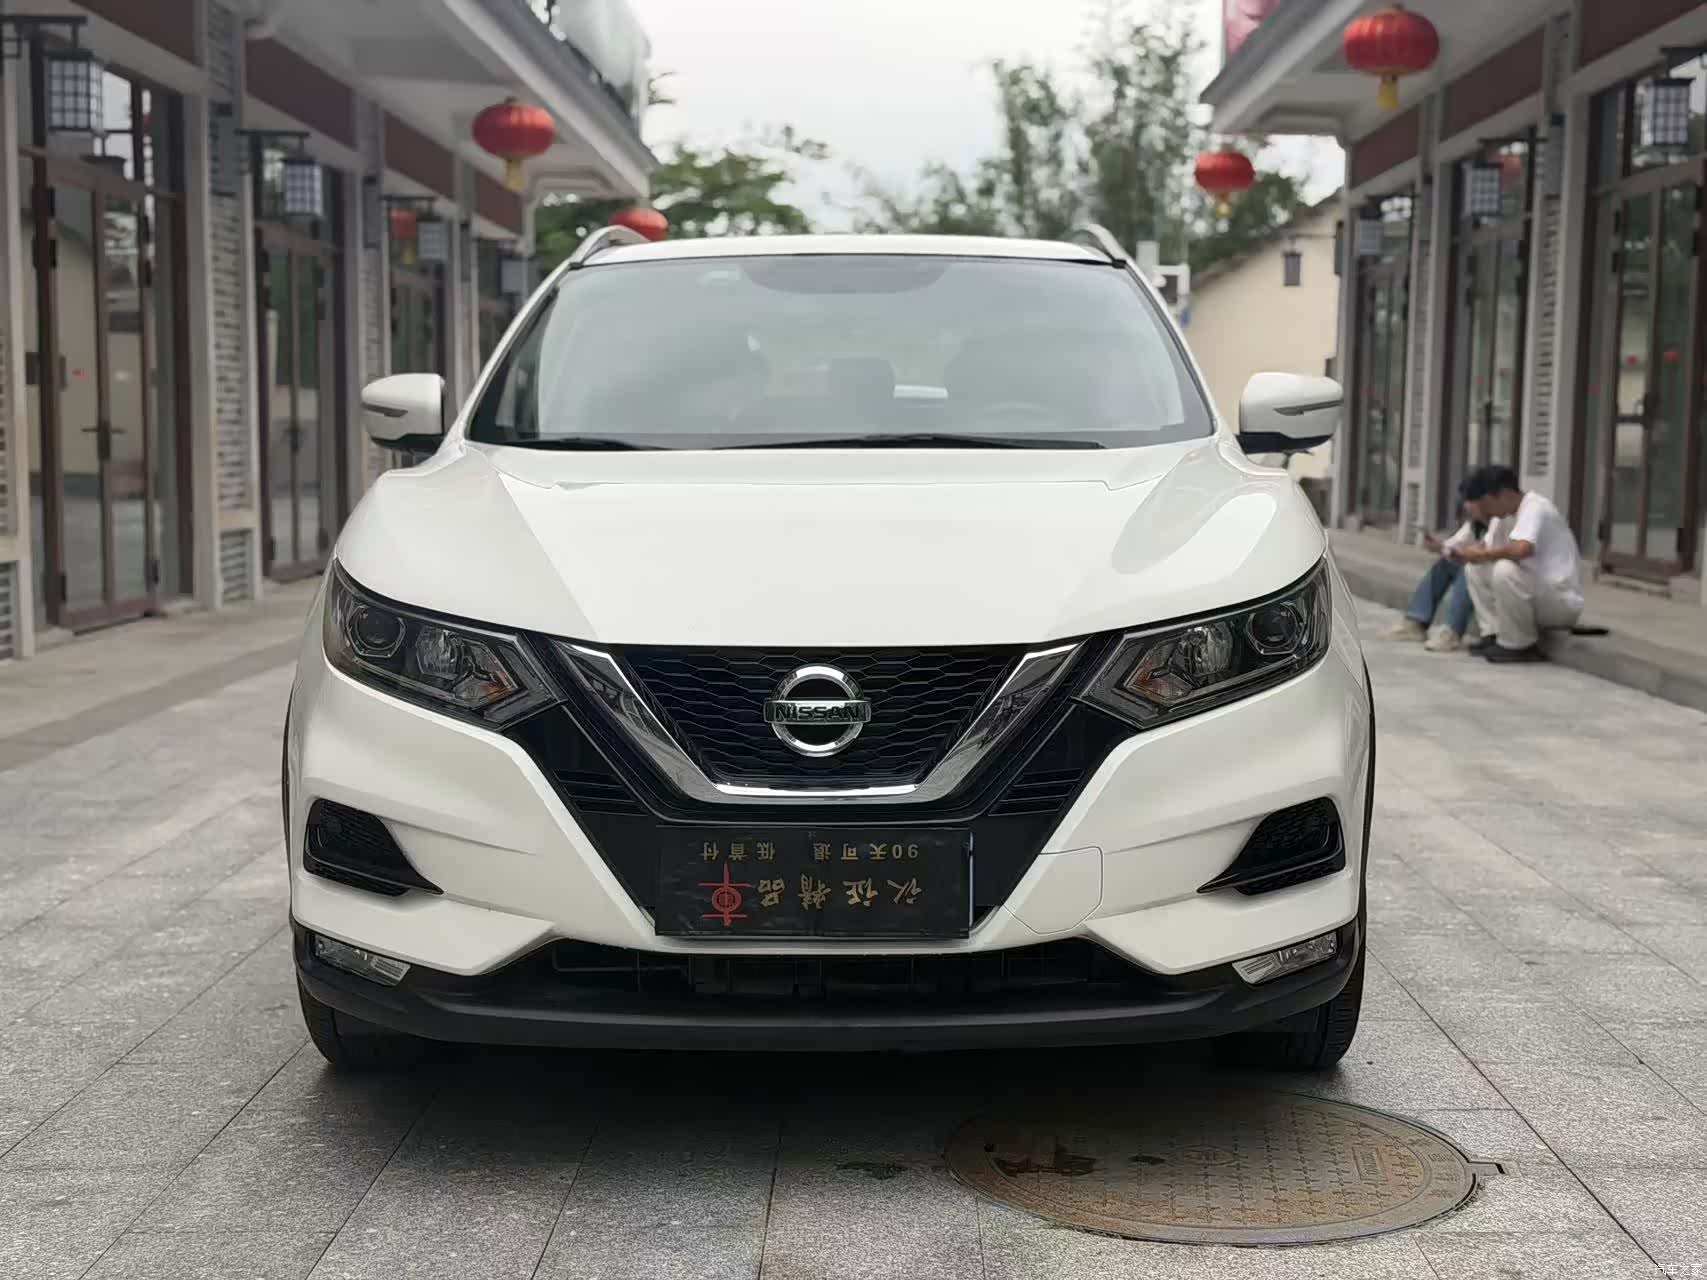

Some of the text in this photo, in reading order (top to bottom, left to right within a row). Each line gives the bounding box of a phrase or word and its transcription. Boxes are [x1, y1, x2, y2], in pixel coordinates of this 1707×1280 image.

[773, 704, 863, 722] NISSAN
[699, 841, 919, 861] 90天可退 低首付
